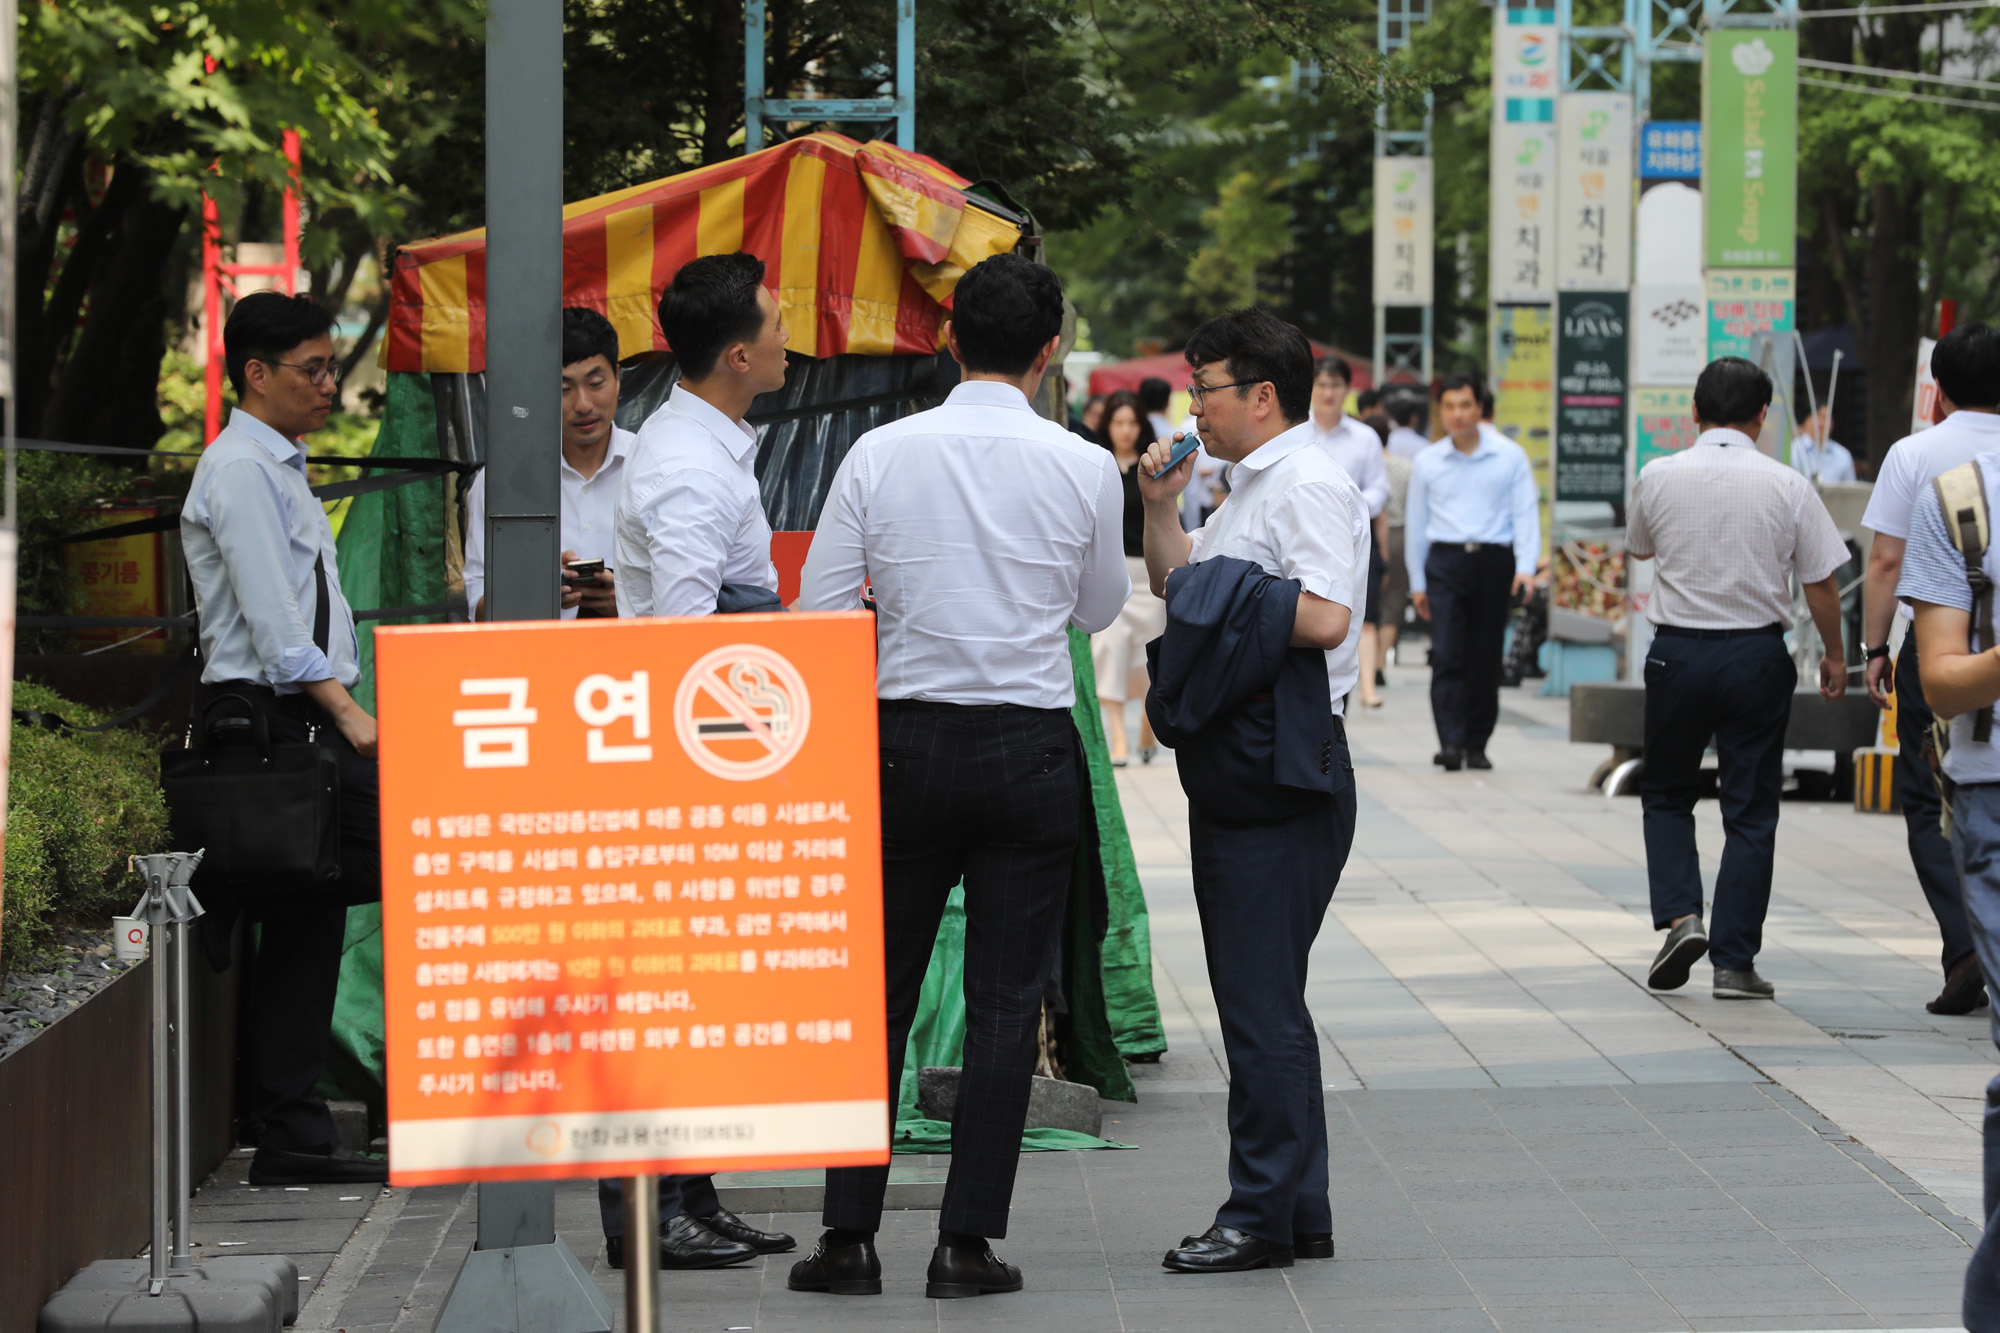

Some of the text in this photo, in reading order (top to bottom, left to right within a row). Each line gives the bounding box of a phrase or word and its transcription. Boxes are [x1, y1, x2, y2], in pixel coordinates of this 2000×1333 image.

[1743, 78, 1766, 147] Salad
[1646, 152, 1702, 172] 지하상
[1737, 180, 1765, 243] Soup
[1514, 224, 1541, 288] 치과
[1575, 205, 1608, 275] 치과
[1392, 243, 1415, 292] 치과
[80, 560, 141, 585] 콩기름
[411, 816, 432, 839] 이
[437, 814, 492, 838] 빌딩은
[498, 809, 640, 834] 국민건강증진법에
[645, 806, 683, 829] 따른
[688, 805, 726, 829] 공중
[731, 803, 768, 827] 이용
[412, 837, 848, 877] 흡연 구역을 시설의 출입구로부터 10M 이상 거리에
[413, 888, 490, 913] 설치토록
[497, 885, 573, 910] 규정하고
[652, 880, 673, 903] 위
[679, 877, 736, 901] 사항을
[745, 875, 801, 899] 위반할
[810, 873, 848, 897] 경우
[414, 925, 486, 950] 건물주에
[491, 922, 541, 945] 500만
[548, 920, 566, 944] 원
[572, 919, 625, 941] 이하의
[630, 916, 683, 939] 과태료
[735, 913, 772, 937] 금연
[777, 910, 849, 933] 구역에서
[414, 946, 850, 987] 흡연한 사람에게는 10만 원 이하의 과태료를 부과하오니
[416, 988, 697, 1023] 이 점을 유념해 주시기 바랍니다.
[416, 1018, 853, 1060] 또한 흡연은 1층에 마련된 외부 흡연 공간을 이용해
[417, 1068, 563, 1098] 주시기 바랍니다.
